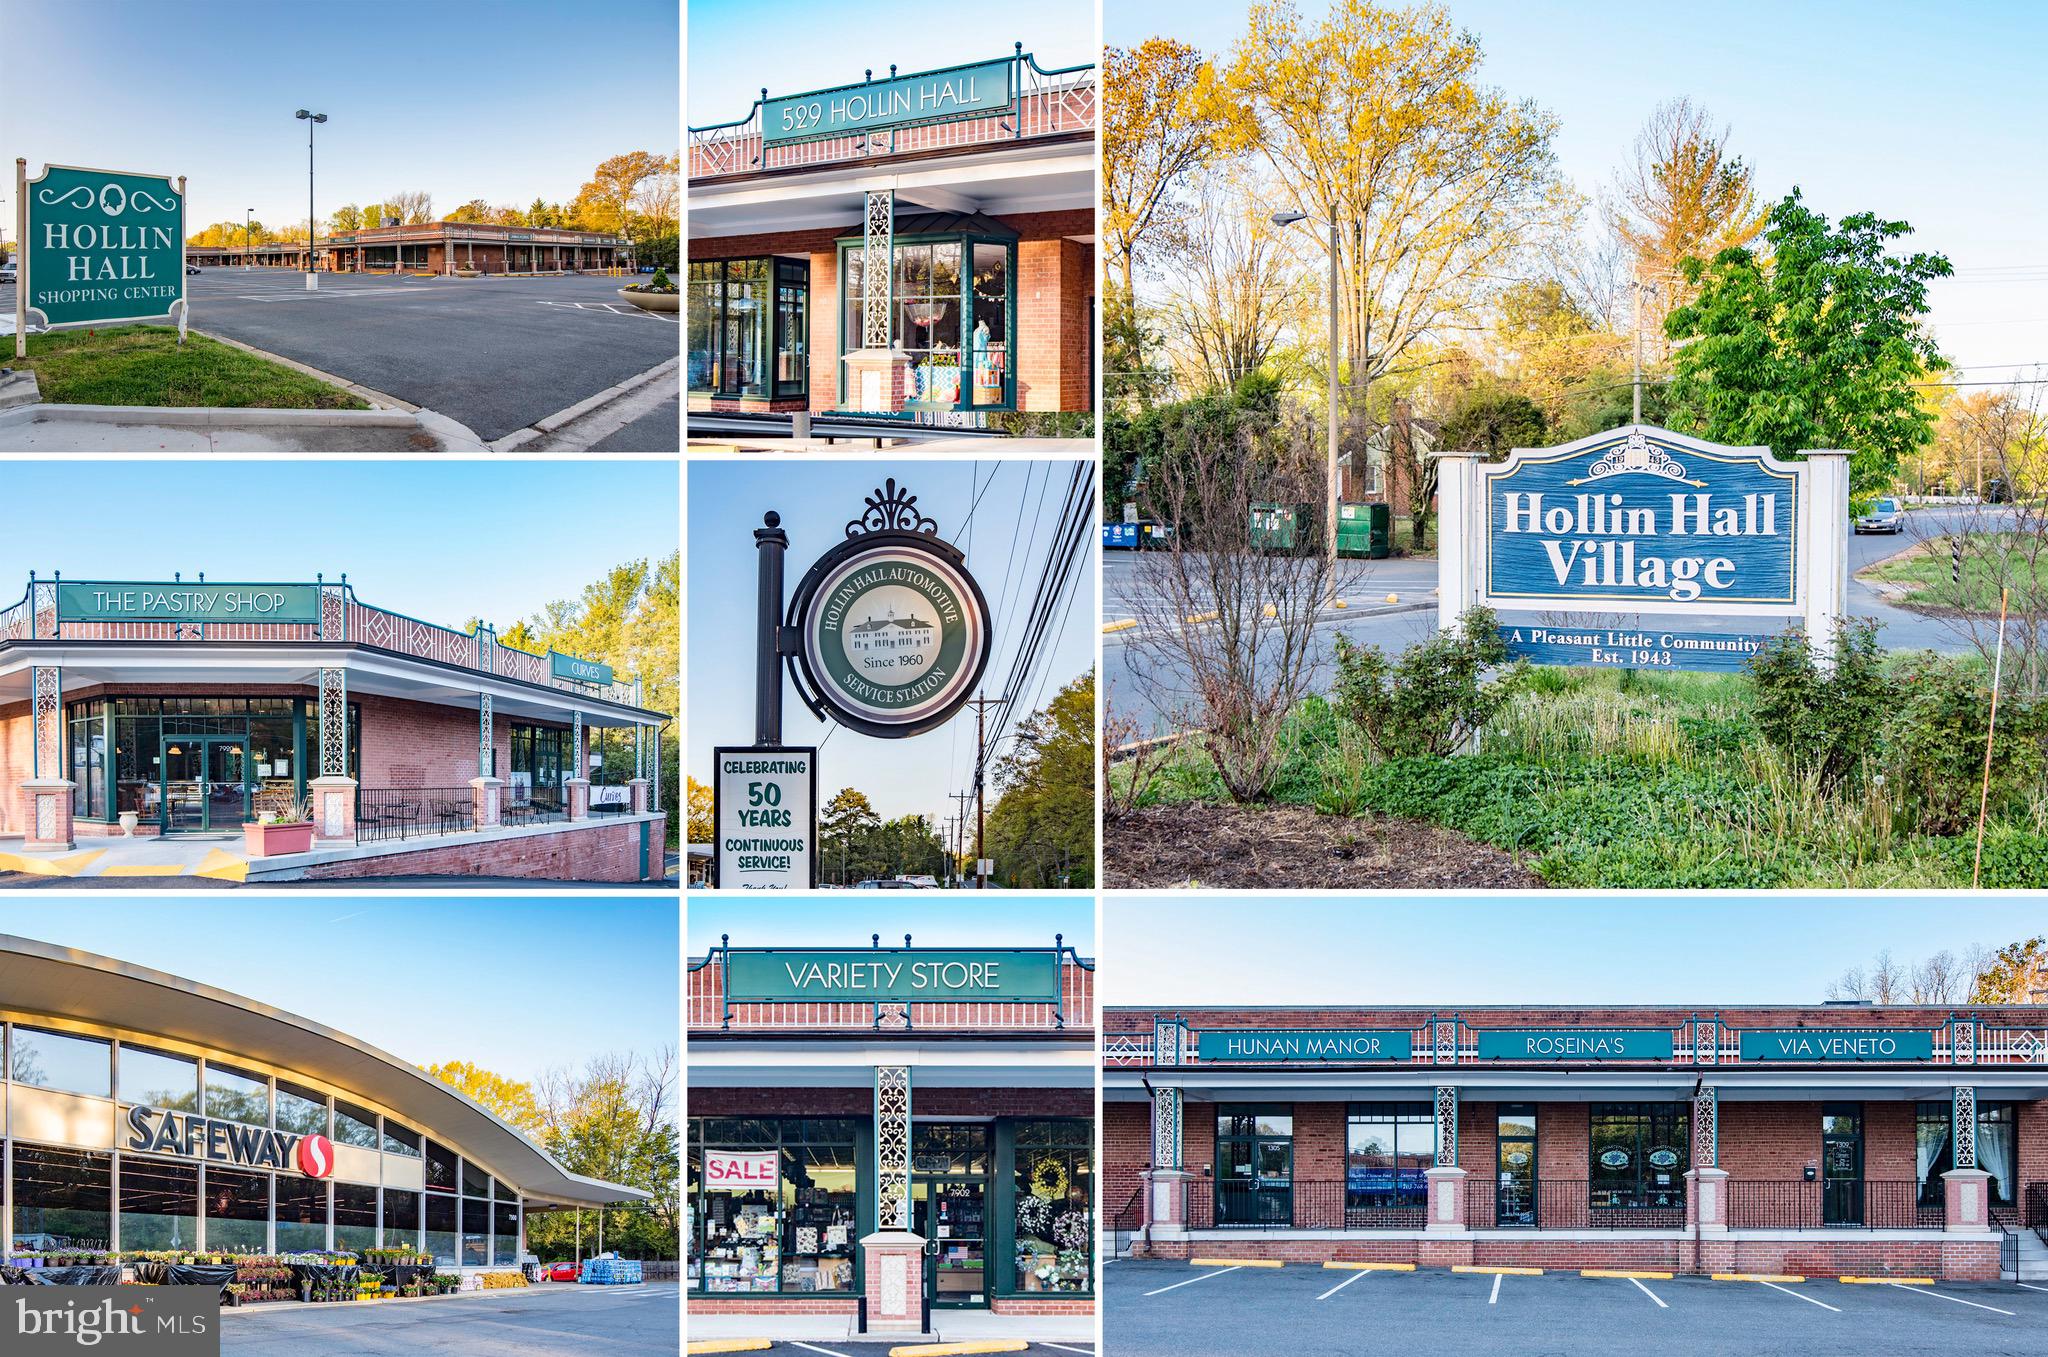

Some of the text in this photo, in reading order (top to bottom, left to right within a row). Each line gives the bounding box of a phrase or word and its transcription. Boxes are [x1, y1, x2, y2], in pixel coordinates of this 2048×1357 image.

[782, 76, 982, 132] 529 HOLLIN HALL
[43, 223, 173, 250] HOLLIN
[67, 255, 156, 281] HALL
[38, 285, 176, 304] SHOPPING CENTER
[1503, 492, 1778, 536] Hollin Hall
[1540, 539, 1736, 601] Village
[93, 591, 285, 613] THE PASTRY SHOP
[824, 567, 959, 632] HOLLIN HALL AUTOMOTIVE
[1510, 629, 1760, 656] A Pleasant Little Community
[864, 654, 924, 669] Since 1960
[1592, 649, 1671, 666] Est. 1943
[571, 662, 600, 680] CURVES
[843, 666, 947, 703] SERVICE STATION
[724, 760, 806, 774] CELEBRATING
[748, 781, 781, 806] 50
[738, 809, 792, 828] YEARS
[725, 839, 804, 852] CONTINUOUS
[738, 856, 791, 869] SERVICE!
[785, 961, 999, 989] VARIETY STORE
[1228, 1038, 1380, 1055] HUNAN MANOR
[1526, 1037, 1625, 1055] ROSEINA'S
[1778, 1038, 1896, 1055] VIA VENETO
[128, 1105, 298, 1170] SAFEWAY
[708, 1159, 775, 1181] SALE
[951, 1189, 970, 1197] 7902
